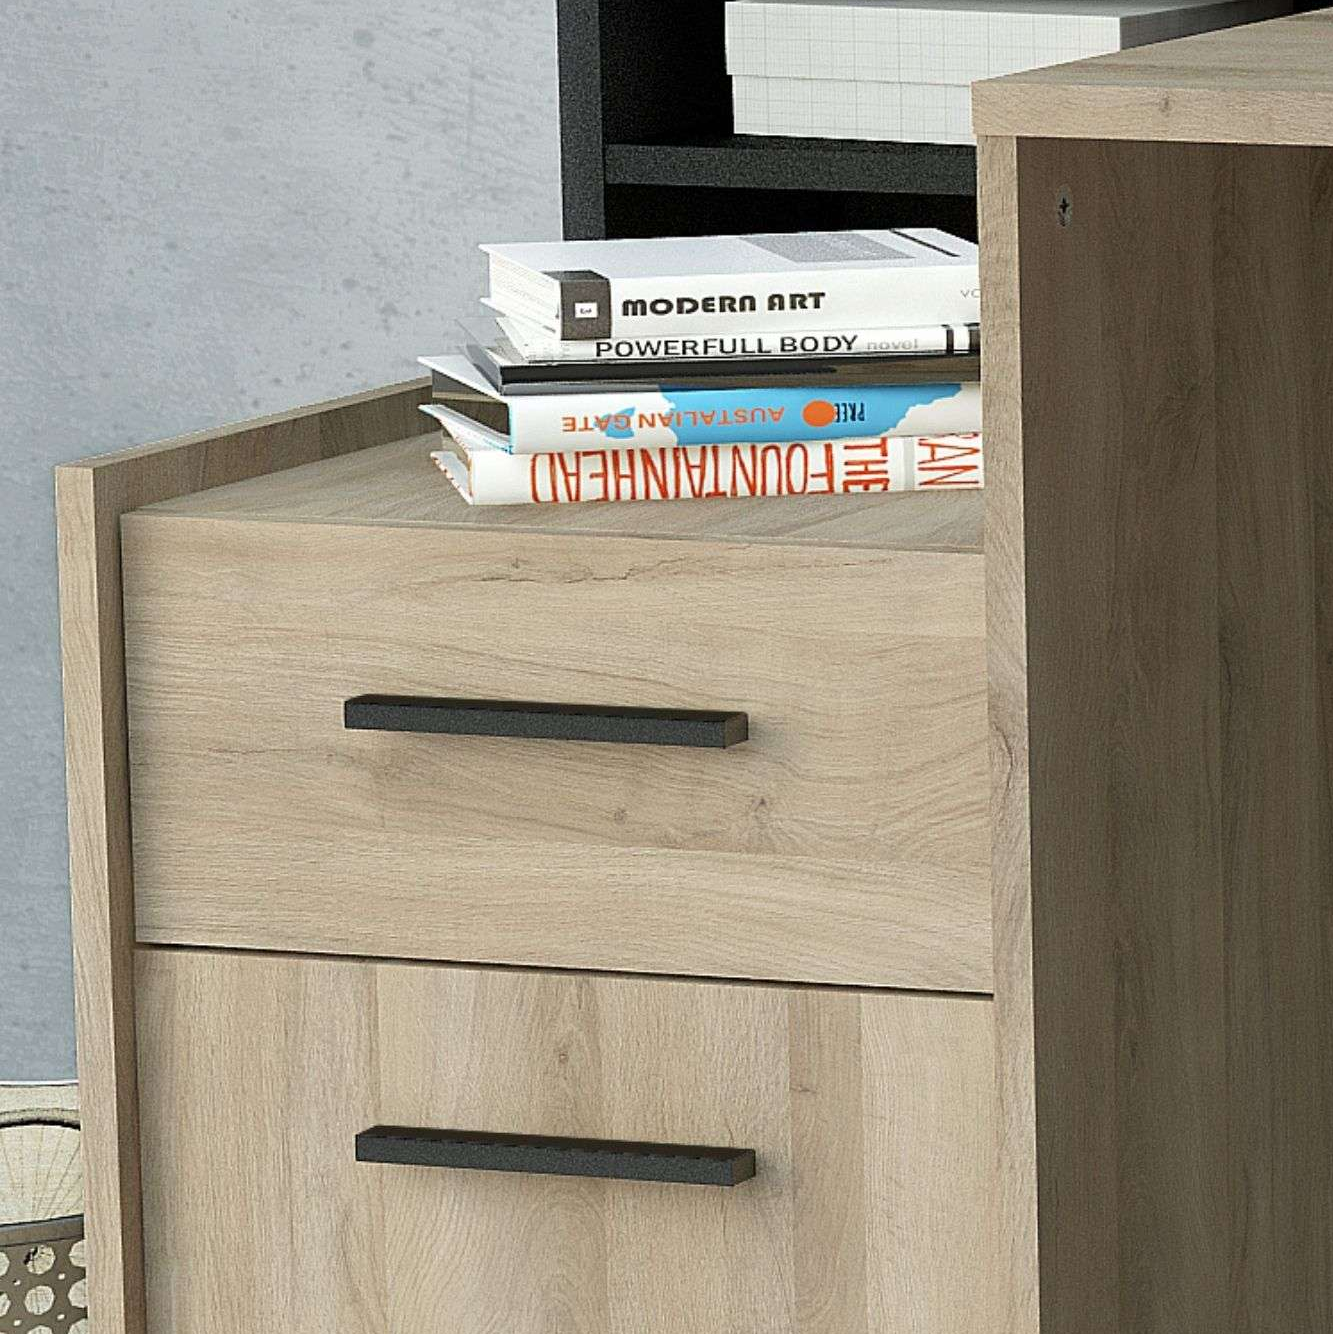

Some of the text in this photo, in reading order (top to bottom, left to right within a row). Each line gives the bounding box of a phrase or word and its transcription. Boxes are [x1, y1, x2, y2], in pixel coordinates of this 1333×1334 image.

[621, 291, 826, 317] MODERN ART
[595, 335, 920, 359] POWERFULL BODY novel
[560, 414, 634, 434] GATE
[530, 441, 836, 505] FOUNTAINHEAD
